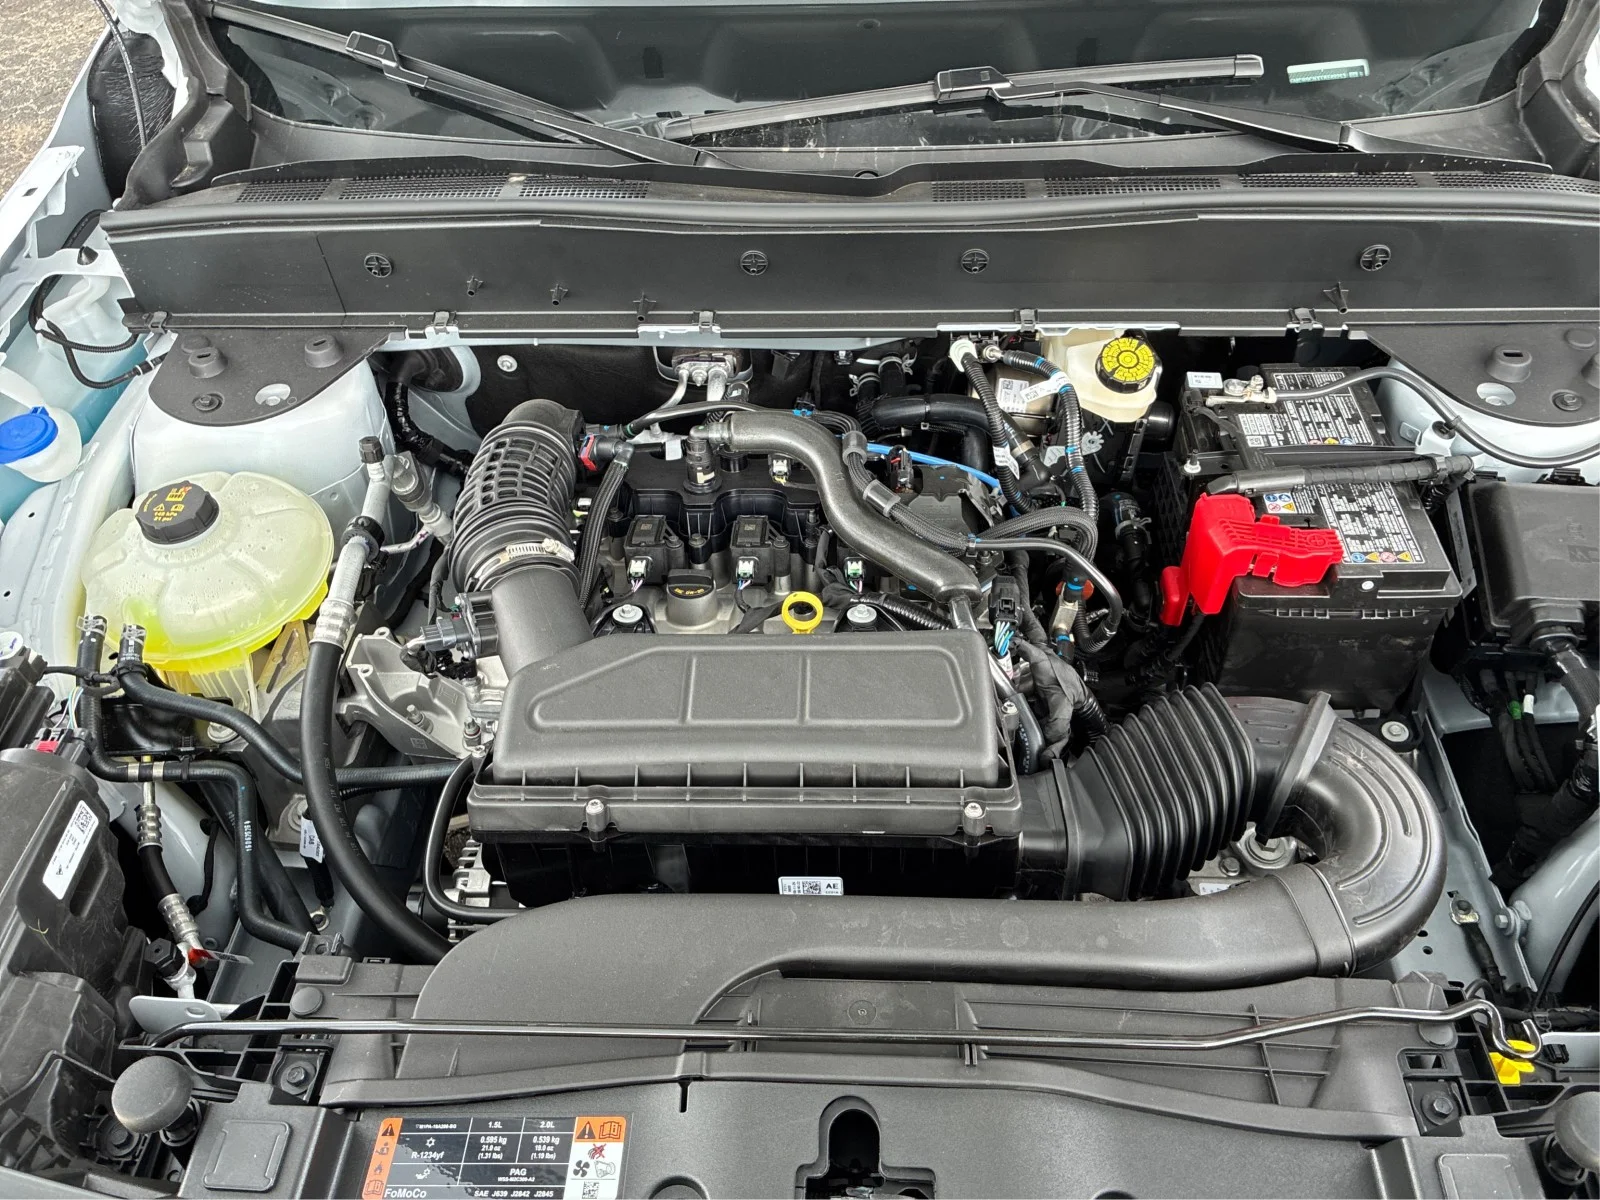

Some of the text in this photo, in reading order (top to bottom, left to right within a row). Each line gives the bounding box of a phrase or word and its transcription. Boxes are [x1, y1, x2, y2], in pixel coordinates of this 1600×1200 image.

[488, 1121, 503, 1129] 1.5L
[539, 1120, 555, 1129] 2.0L
[498, 1135, 508, 1145] kg
[532, 1135, 560, 1145] 0.539 kg
[411, 1150, 445, 1161] R-1234yf
[509, 1168, 528, 1176] PAG
[384, 1188, 427, 1199] FoMoCo
